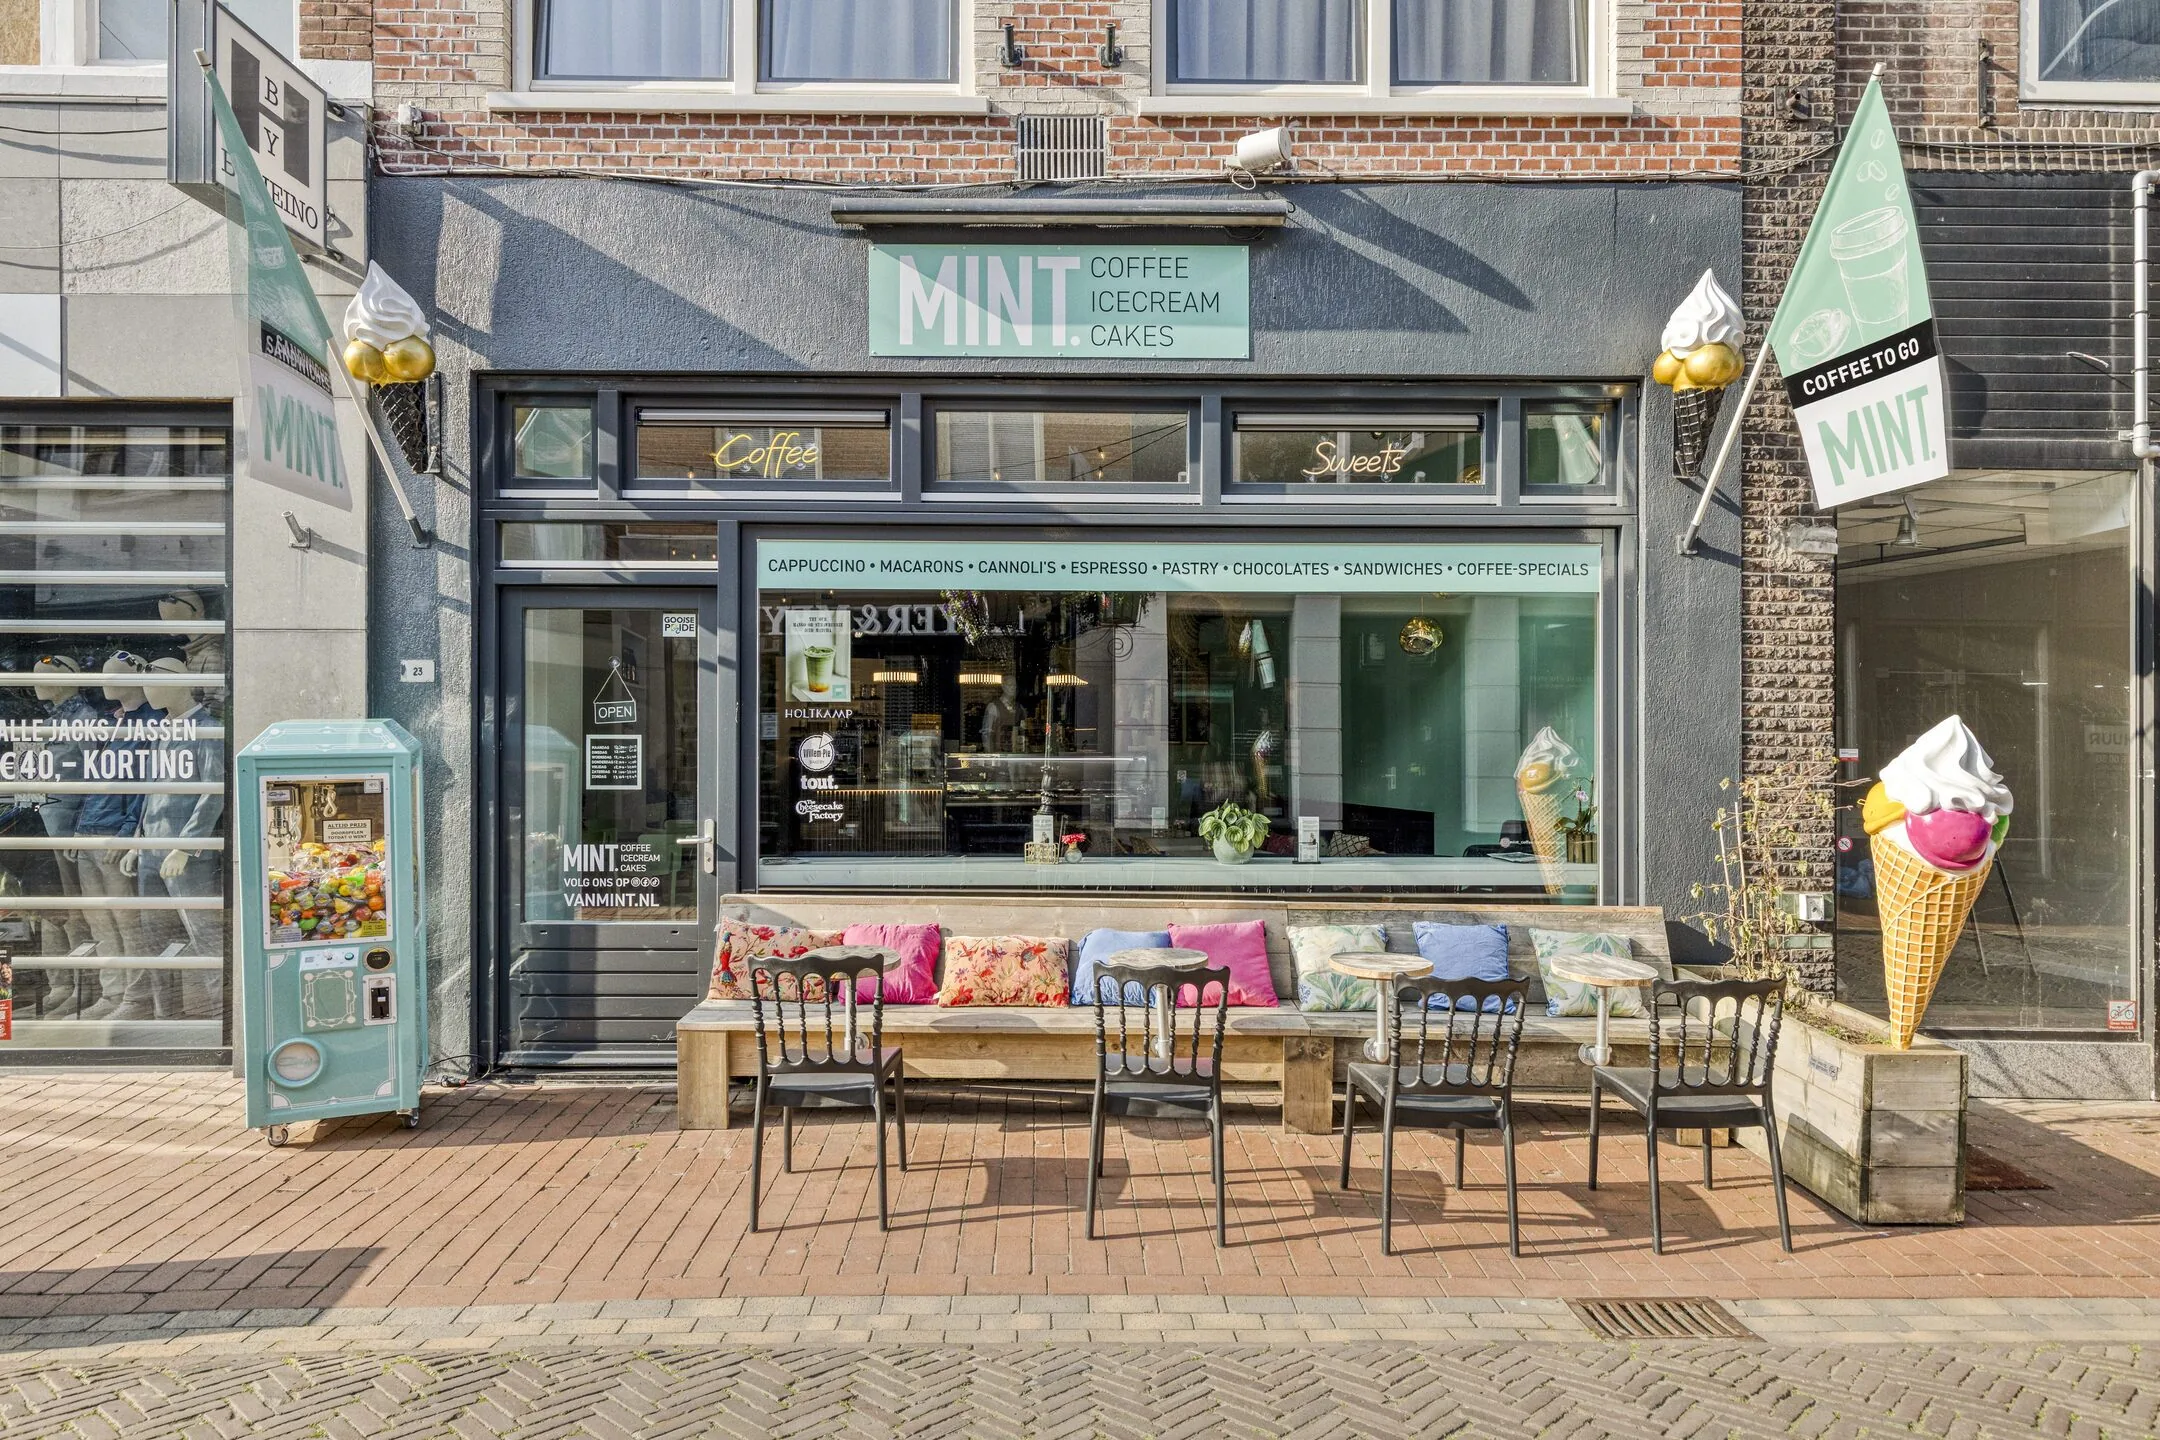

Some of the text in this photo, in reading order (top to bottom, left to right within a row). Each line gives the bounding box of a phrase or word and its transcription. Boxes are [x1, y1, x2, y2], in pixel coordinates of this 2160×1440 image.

[899, 255, 1189, 347] MINT. COFFEE
[1091, 290, 1220, 313] ICECREAM
[1091, 324, 1175, 347] CAKES
[1802, 337, 1920, 396] COFFEE TO GO
[257, 384, 344, 489] MINT.
[1817, 384, 1937, 486] MINT.
[715, 432, 819, 479] Coffee
[1302, 441, 1407, 475] Sweets
[768, 559, 1590, 577] CAPPUCCINO MACARONS CANNOLI'S ESPRESSO PASTRY CHOCOLATES SANDWICHES COFFEE-SPECIALS
[664, 616, 695, 624] GOOISE
[412, 666, 424, 677] 23
[598, 705, 633, 719] OPEN
[784, 708, 853, 719] HOLTKAMP
[0, 718, 197, 742] ALLE JACKS/JASSEN
[803, 748, 831, 758] Willem Pie
[83, 750, 194, 780] KORTING
[800, 774, 839, 790] tout.
[796, 800, 844, 814] Cheesecake
[809, 810, 844, 823] Factory
[563, 844, 651, 872] MINT. COFFEE
[620, 854, 661, 862] ICECREAM
[620, 864, 647, 872] CAKES
[564, 877, 630, 888] VOLG ONS OP
[563, 892, 660, 907] VANMINT.NL
